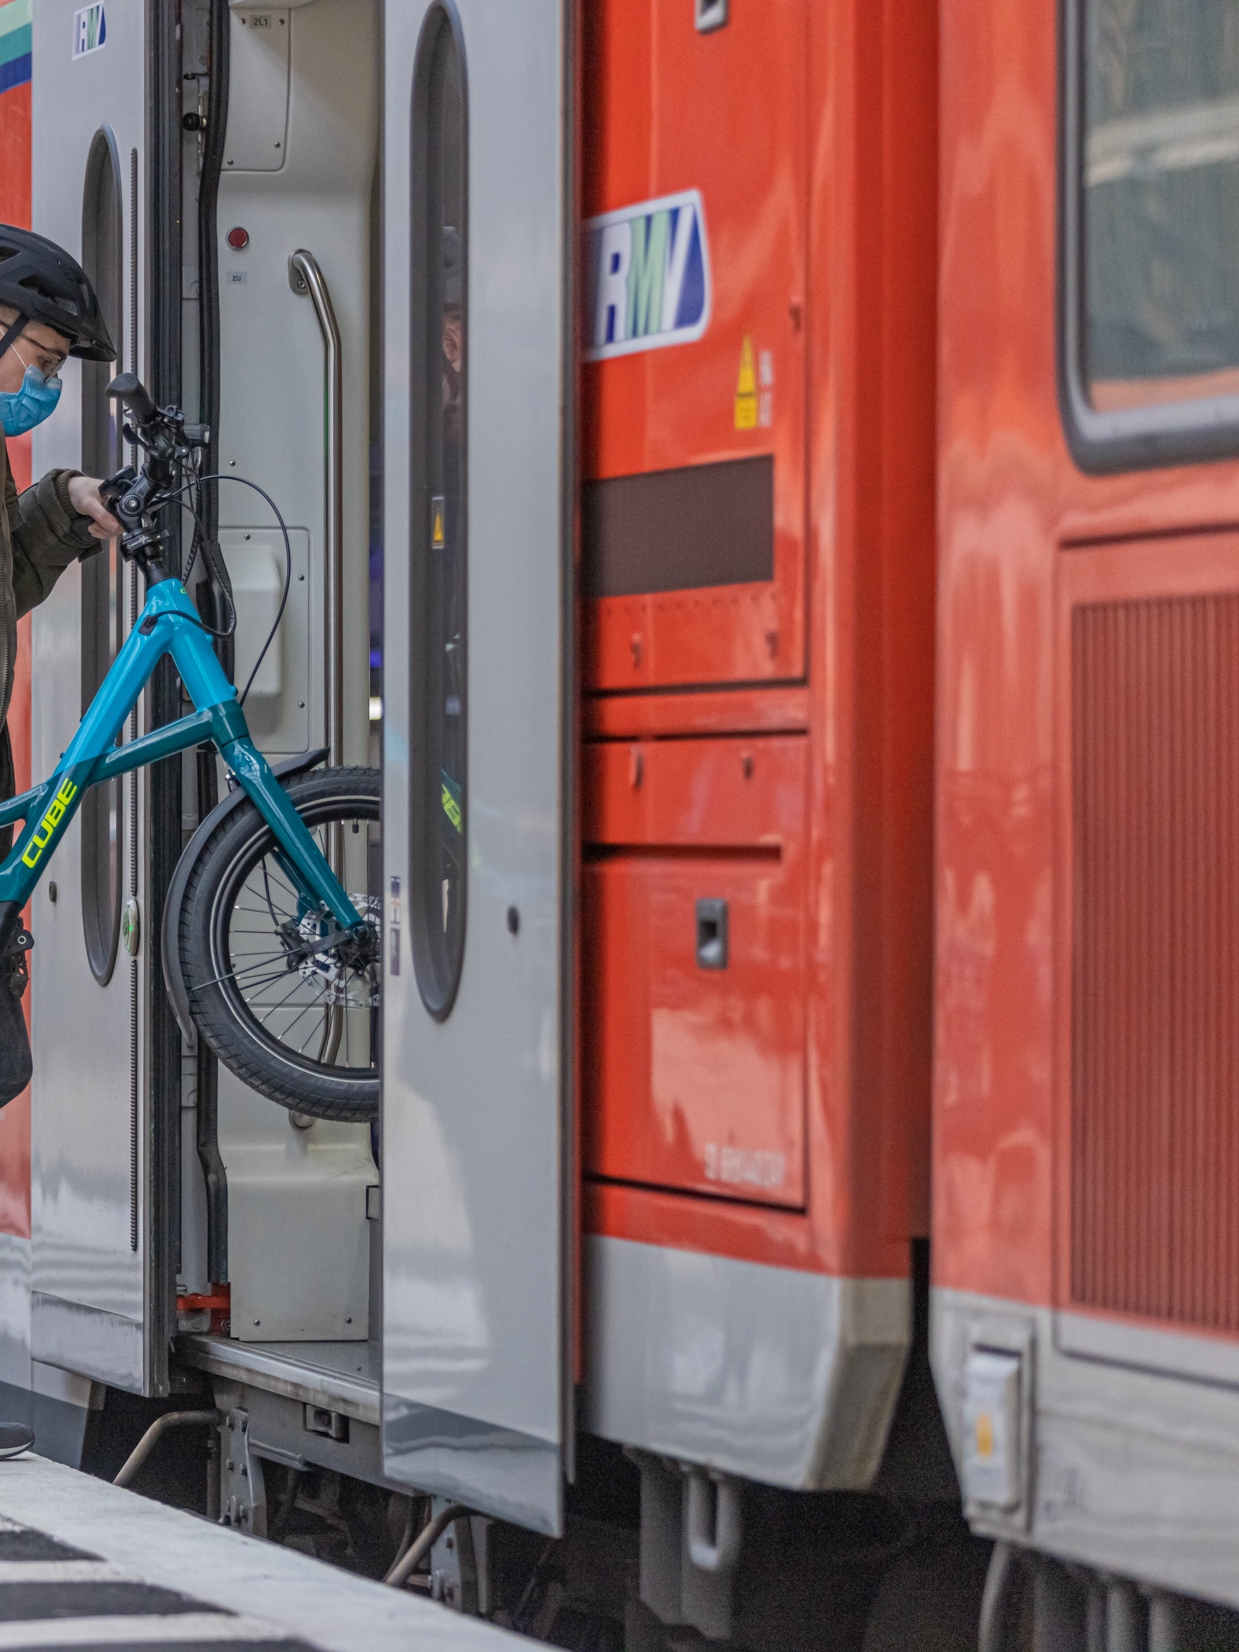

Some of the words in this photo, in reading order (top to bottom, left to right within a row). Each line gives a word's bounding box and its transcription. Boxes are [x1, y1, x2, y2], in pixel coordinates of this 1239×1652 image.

[78, 4, 103, 54] RMV
[253, 17, 268, 26] 2L1
[595, 204, 694, 347] RMV
[22, 777, 78, 868] CUBE
